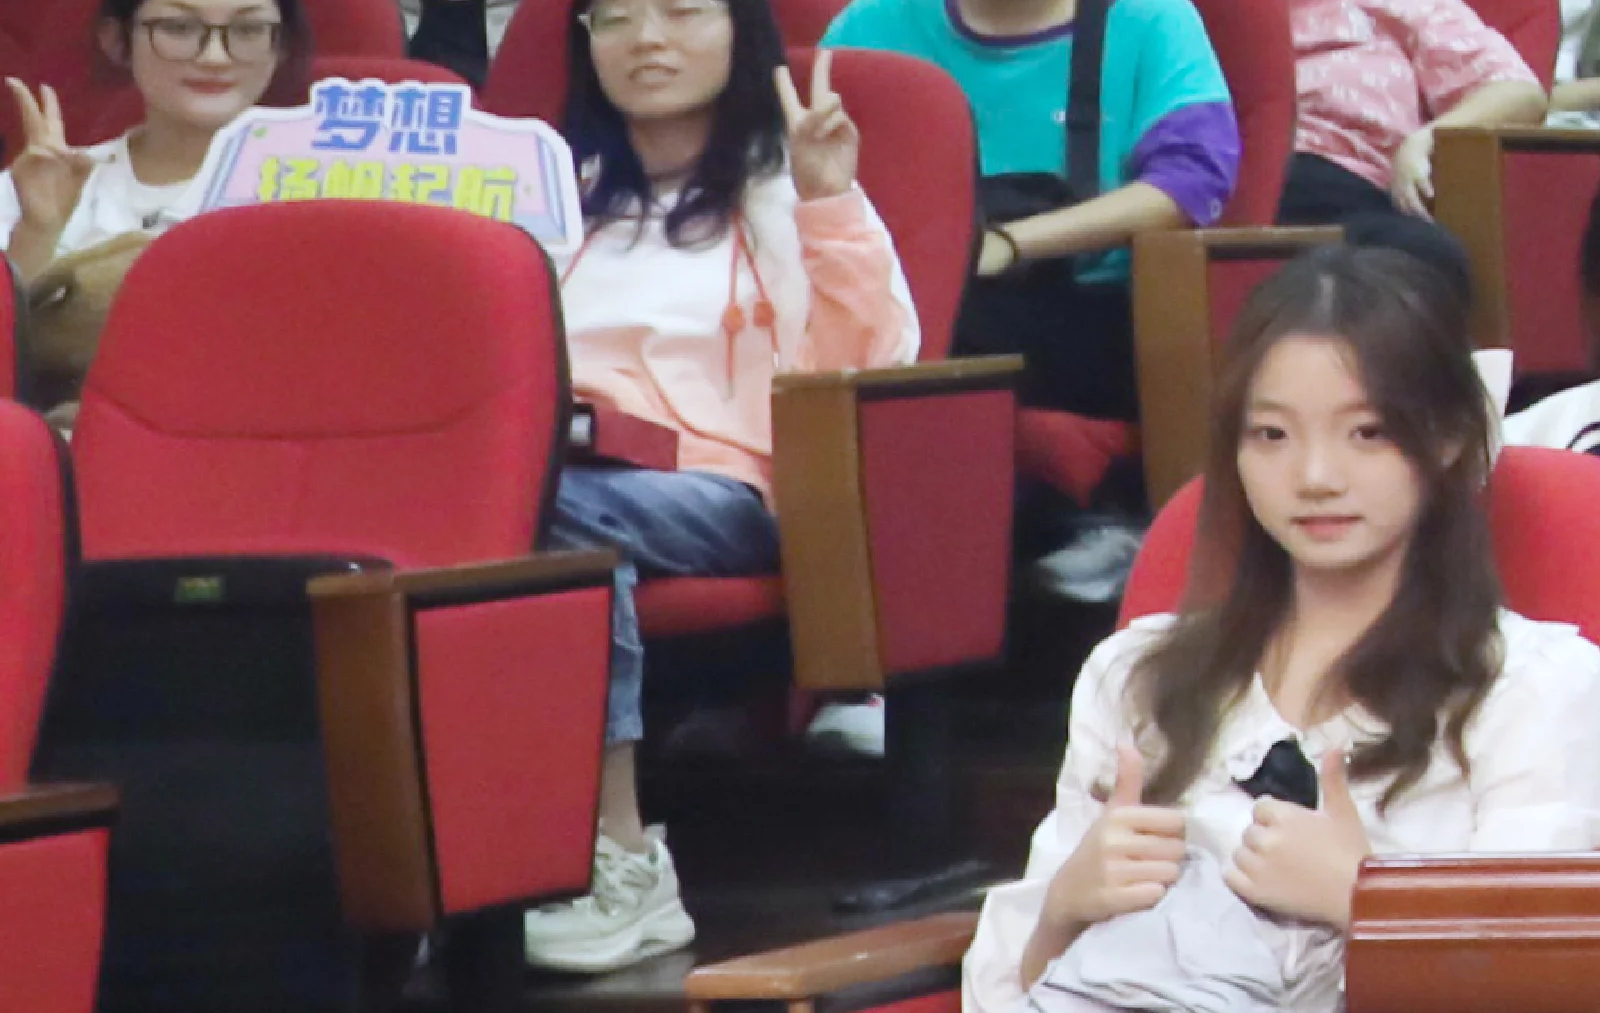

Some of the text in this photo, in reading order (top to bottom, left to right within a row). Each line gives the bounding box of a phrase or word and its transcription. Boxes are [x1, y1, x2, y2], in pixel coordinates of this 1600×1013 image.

[311, 85, 464, 156] 梦想
[258, 156, 518, 222] 扬帆起航
